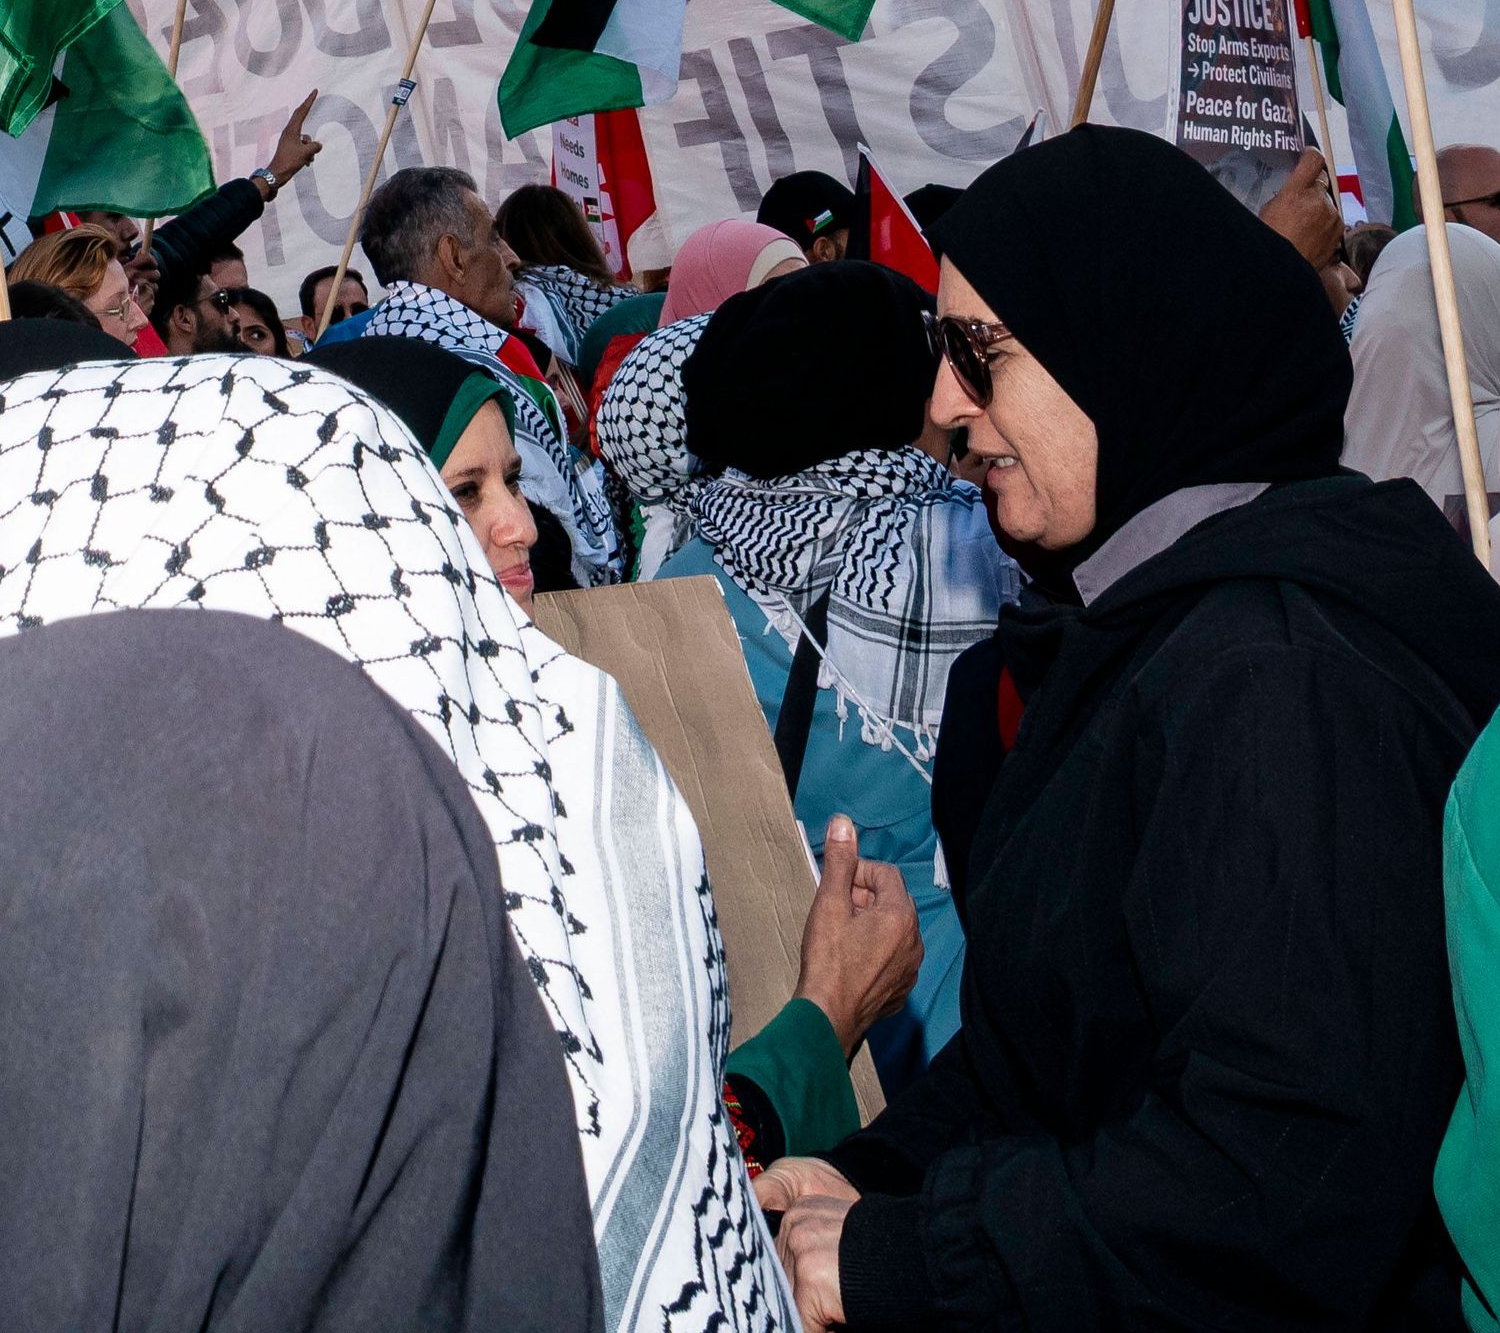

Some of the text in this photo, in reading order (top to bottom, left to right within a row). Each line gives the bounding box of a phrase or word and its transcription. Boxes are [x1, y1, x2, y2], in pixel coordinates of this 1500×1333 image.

[1187, 32, 1291, 64] Stop Arms Exports
[1201, 60, 1293, 90] Protect Civilians
[1186, 90, 1294, 125] Peace for Gaza
[559, 132, 585, 159] Needs
[1183, 120, 1301, 152] Human Rights First
[560, 161, 590, 190] Homes
